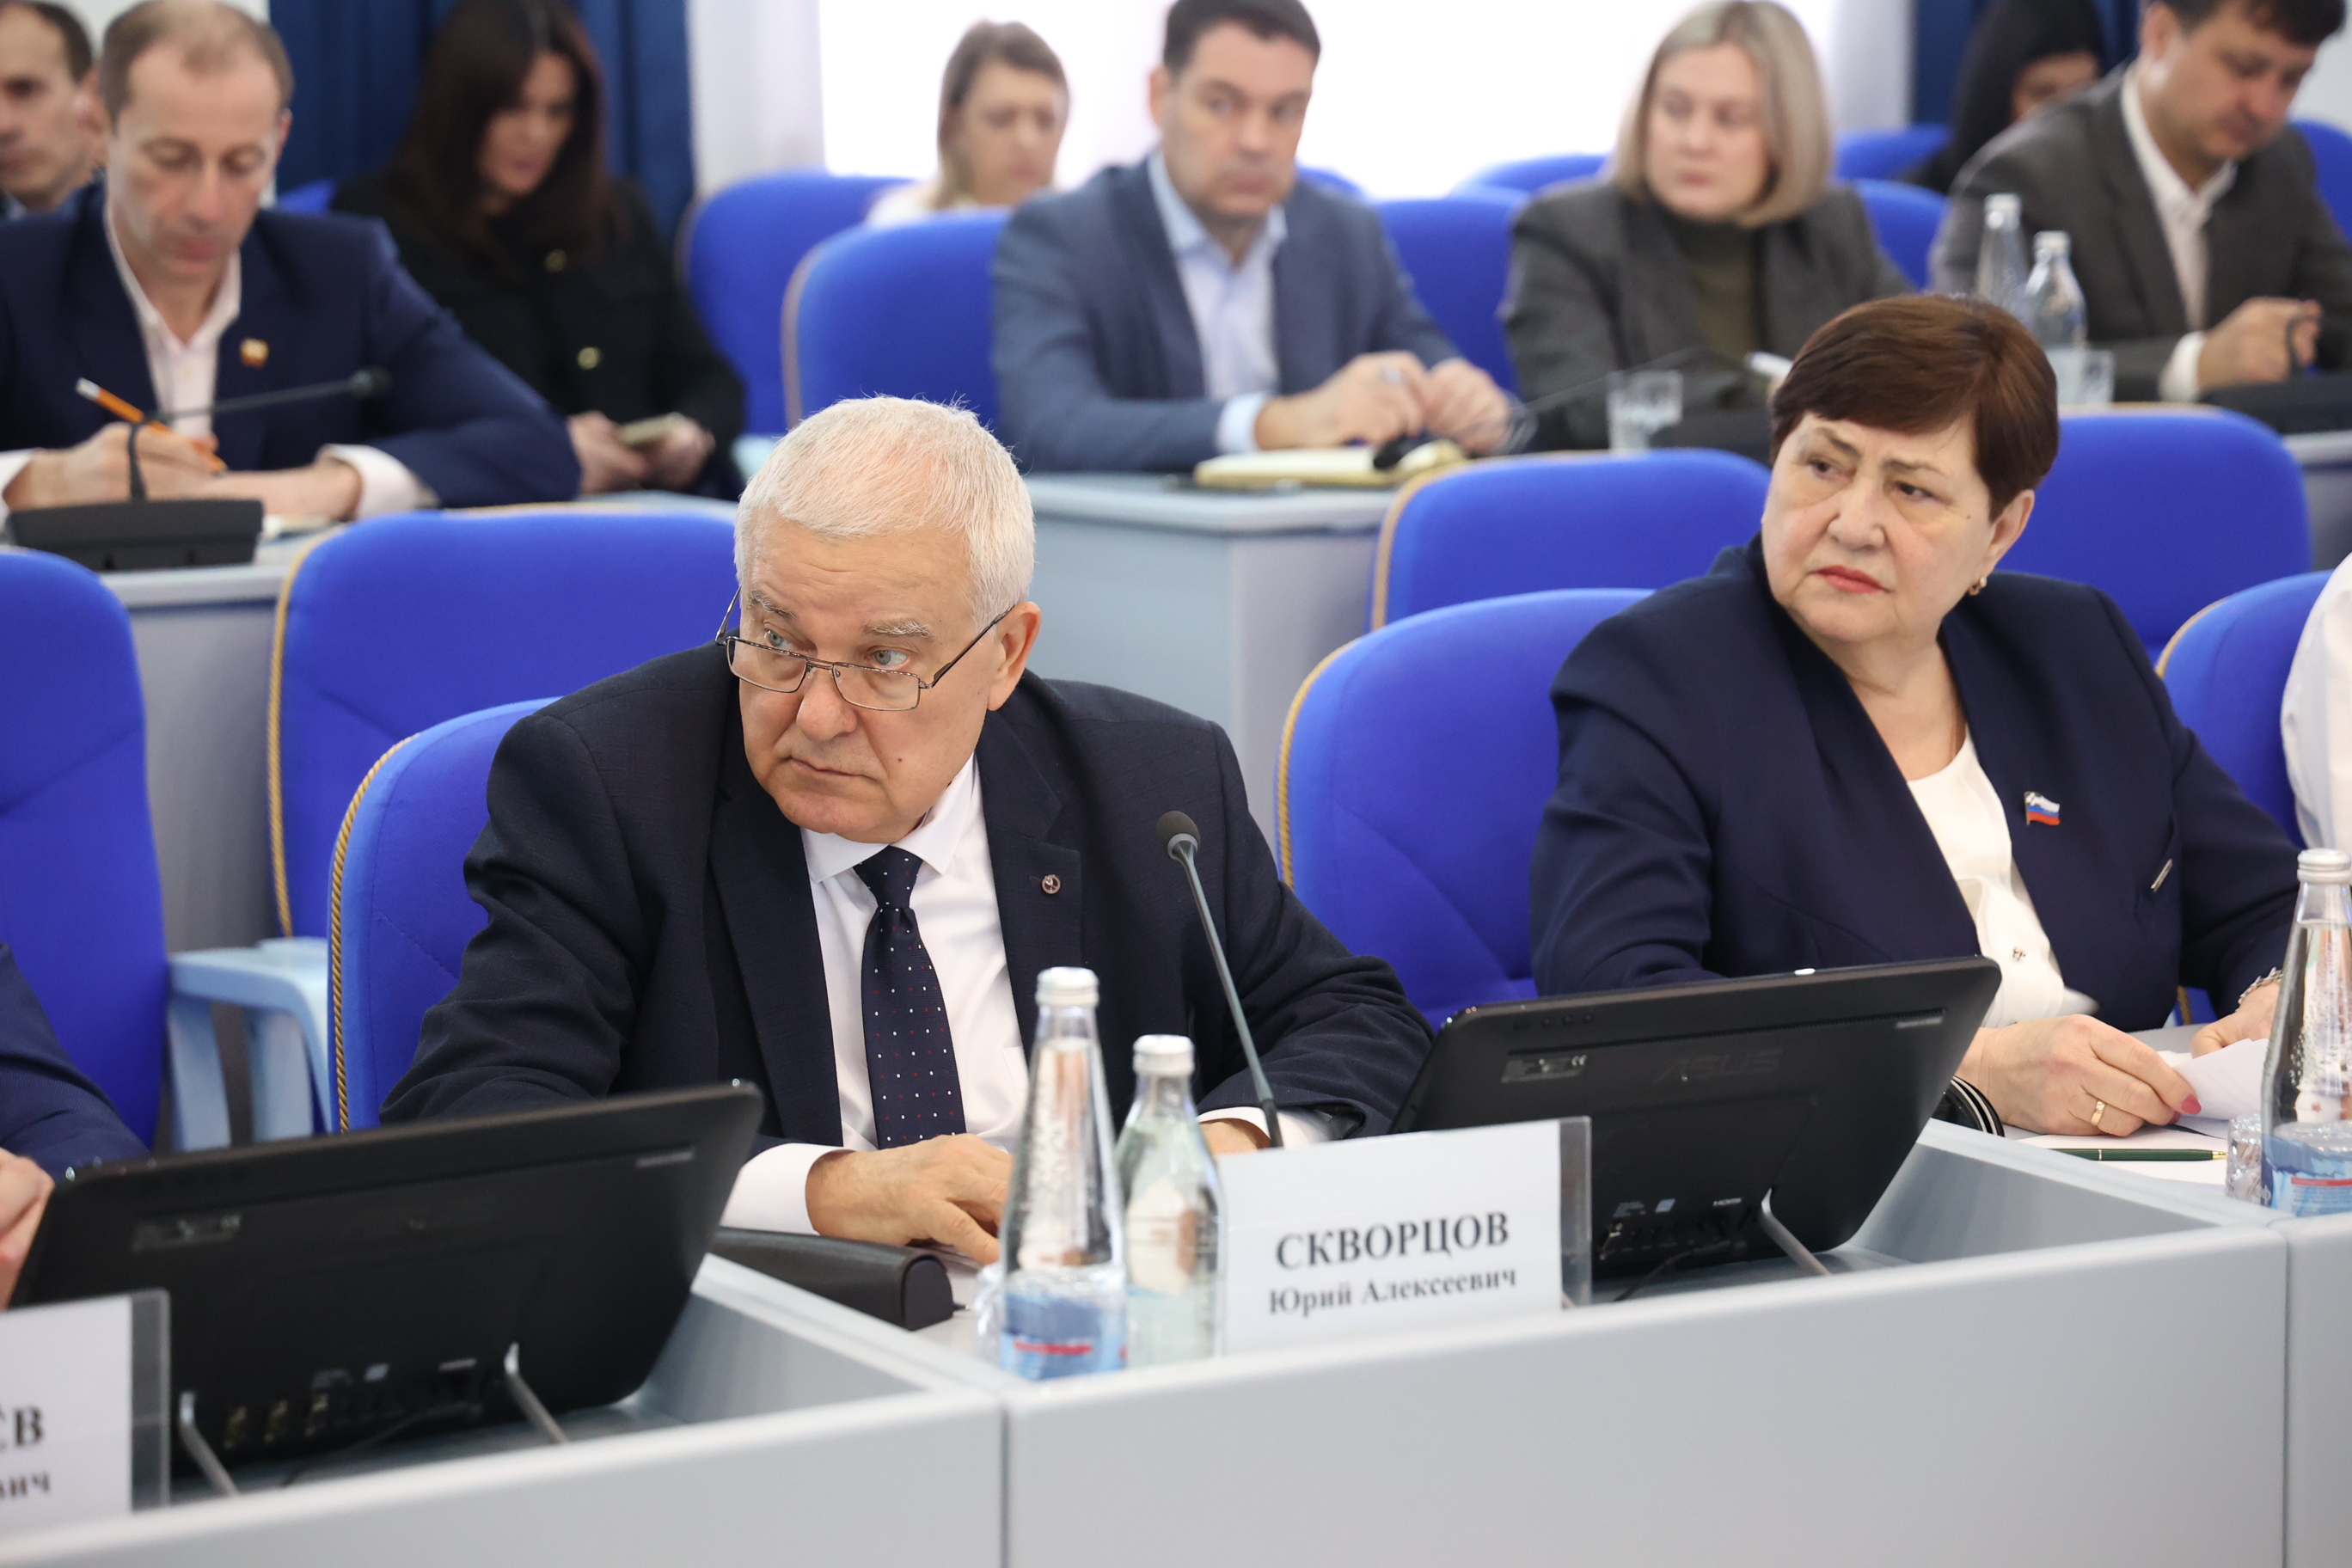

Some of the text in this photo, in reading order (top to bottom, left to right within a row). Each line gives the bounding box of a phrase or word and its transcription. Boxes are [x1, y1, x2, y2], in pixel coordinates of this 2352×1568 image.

[1652, 1047, 1783, 1083] ASUS
[1276, 1212, 1509, 1270] СКВОРЦОВ
[1270, 1269, 1516, 1318] Юрий Алексеевич
[0, 1405, 44, 1449] В
